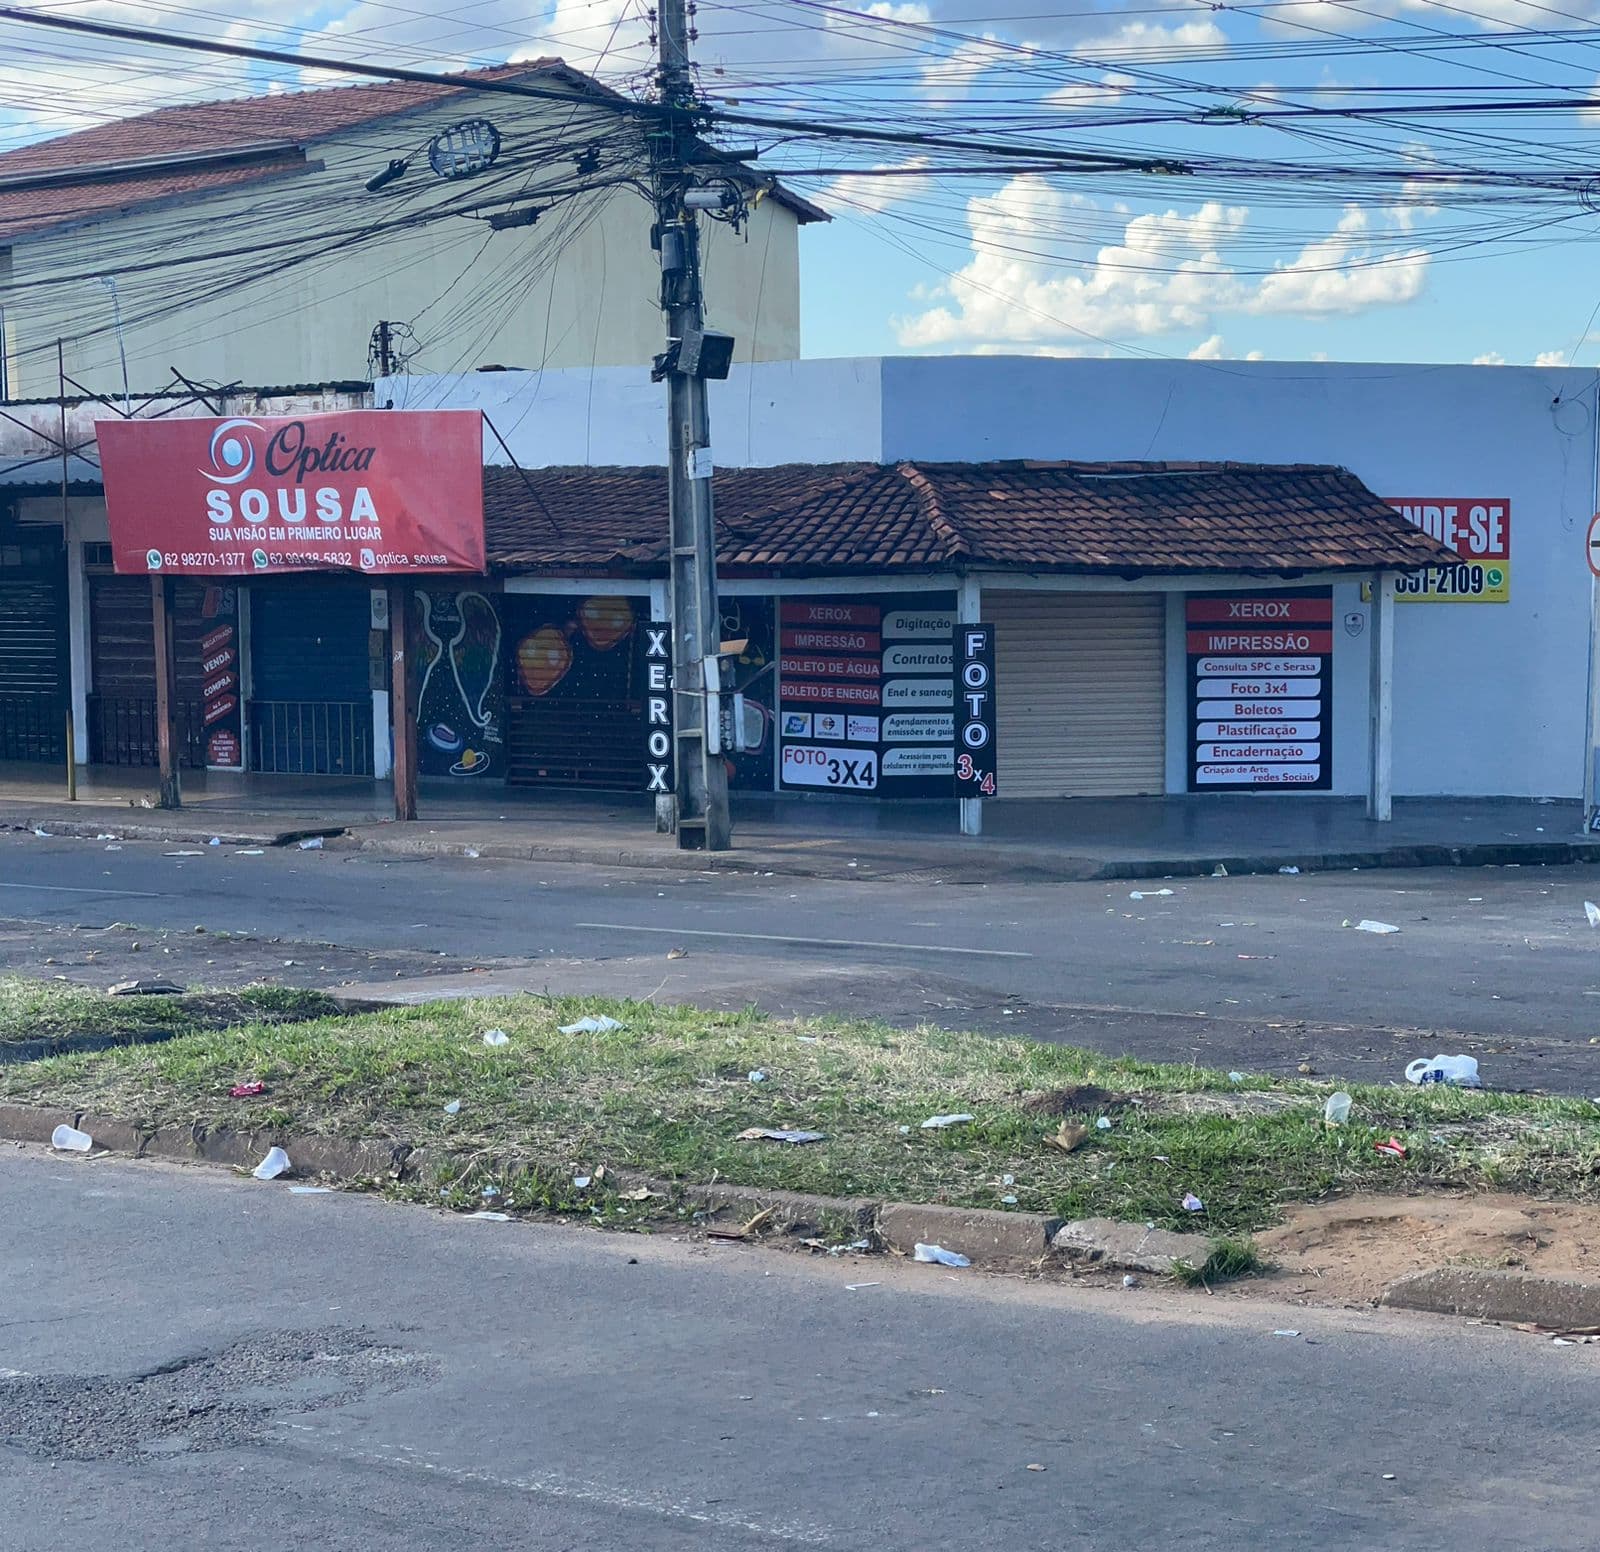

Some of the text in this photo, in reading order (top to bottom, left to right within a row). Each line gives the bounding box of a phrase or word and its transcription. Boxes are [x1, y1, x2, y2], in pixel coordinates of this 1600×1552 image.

[265, 421, 376, 483] Optica
[207, 487, 379, 522] SOUSA
[209, 524, 381, 541] SUA VISÃO EM PRIMEIRO LUGAR
[164, 553, 178, 566] 62
[181, 552, 245, 566] 98270-1377
[270, 553, 284, 564] 62
[286, 552, 352, 566] 99138-5832
[809, 607, 851, 620] XEROX
[1229, 603, 1290, 617] XEROX
[896, 618, 950, 632] Digitação
[795, 633, 866, 648] IMPRESSÃO
[1209, 633, 1309, 650] IMPRESSÃO
[203, 651, 230, 673] VENDA
[892, 653, 954, 665] Contratos
[781, 660, 879, 675] BOLETO DE ÁGUA
[1204, 663, 1247, 671] Consulta
[1250, 663, 1271, 671] SPC
[1283, 663, 1315, 671] Serasa
[204, 675, 232, 697] COMPRA
[781, 685, 879, 700] BOLETO DE ENERGIA
[888, 688, 908, 697] Enel
[962, 631, 989, 749] FOTO
[1231, 682, 1288, 694] Foto 3x4
[646, 630, 670, 791] XEROX
[1234, 704, 1283, 715] Boletos
[889, 718, 949, 726] Agendamentos
[888, 727, 923, 736] emissões
[926, 728, 934, 736] de
[1218, 724, 1297, 738] Plastificação
[784, 749, 826, 766] FOTO
[1213, 746, 1303, 759] Encadernação
[827, 759, 874, 786] 3X4
[1203, 766, 1235, 775] Criação
[1237, 766, 1247, 774] de
[1282, 773, 1314, 781] Sociais
